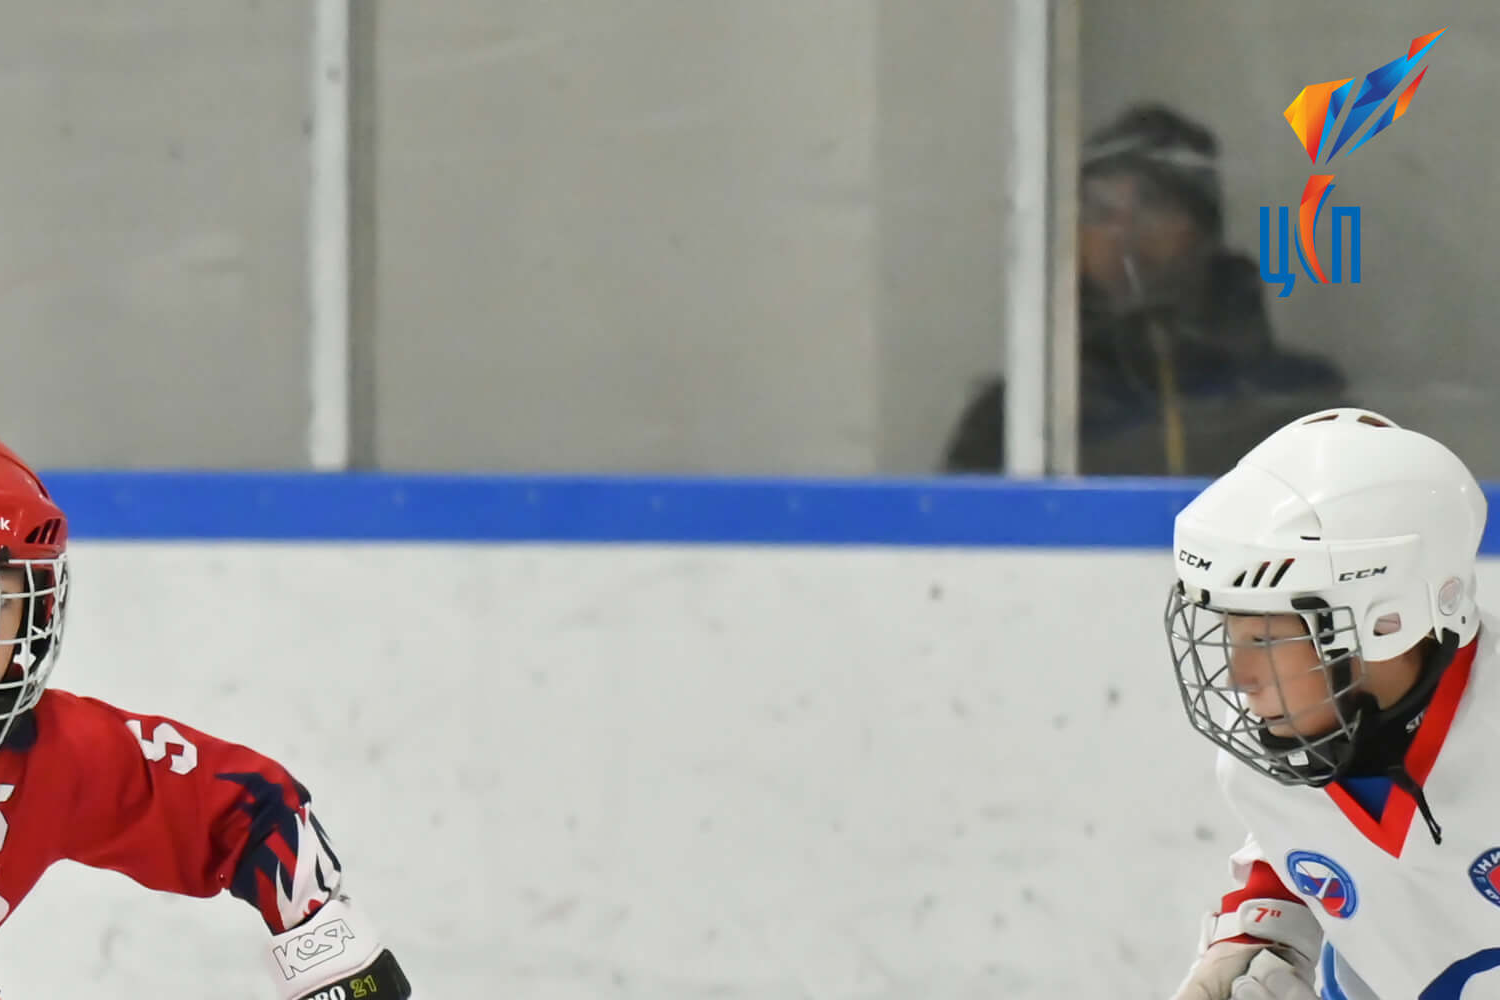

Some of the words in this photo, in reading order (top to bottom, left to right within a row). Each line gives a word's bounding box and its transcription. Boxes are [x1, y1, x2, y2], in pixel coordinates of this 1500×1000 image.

[1178, 549, 1212, 572] CCM
[1338, 565, 1388, 582] CCM
[125, 719, 198, 775] 5
[272, 918, 355, 981] KOSA
[349, 975, 379, 999] 21
